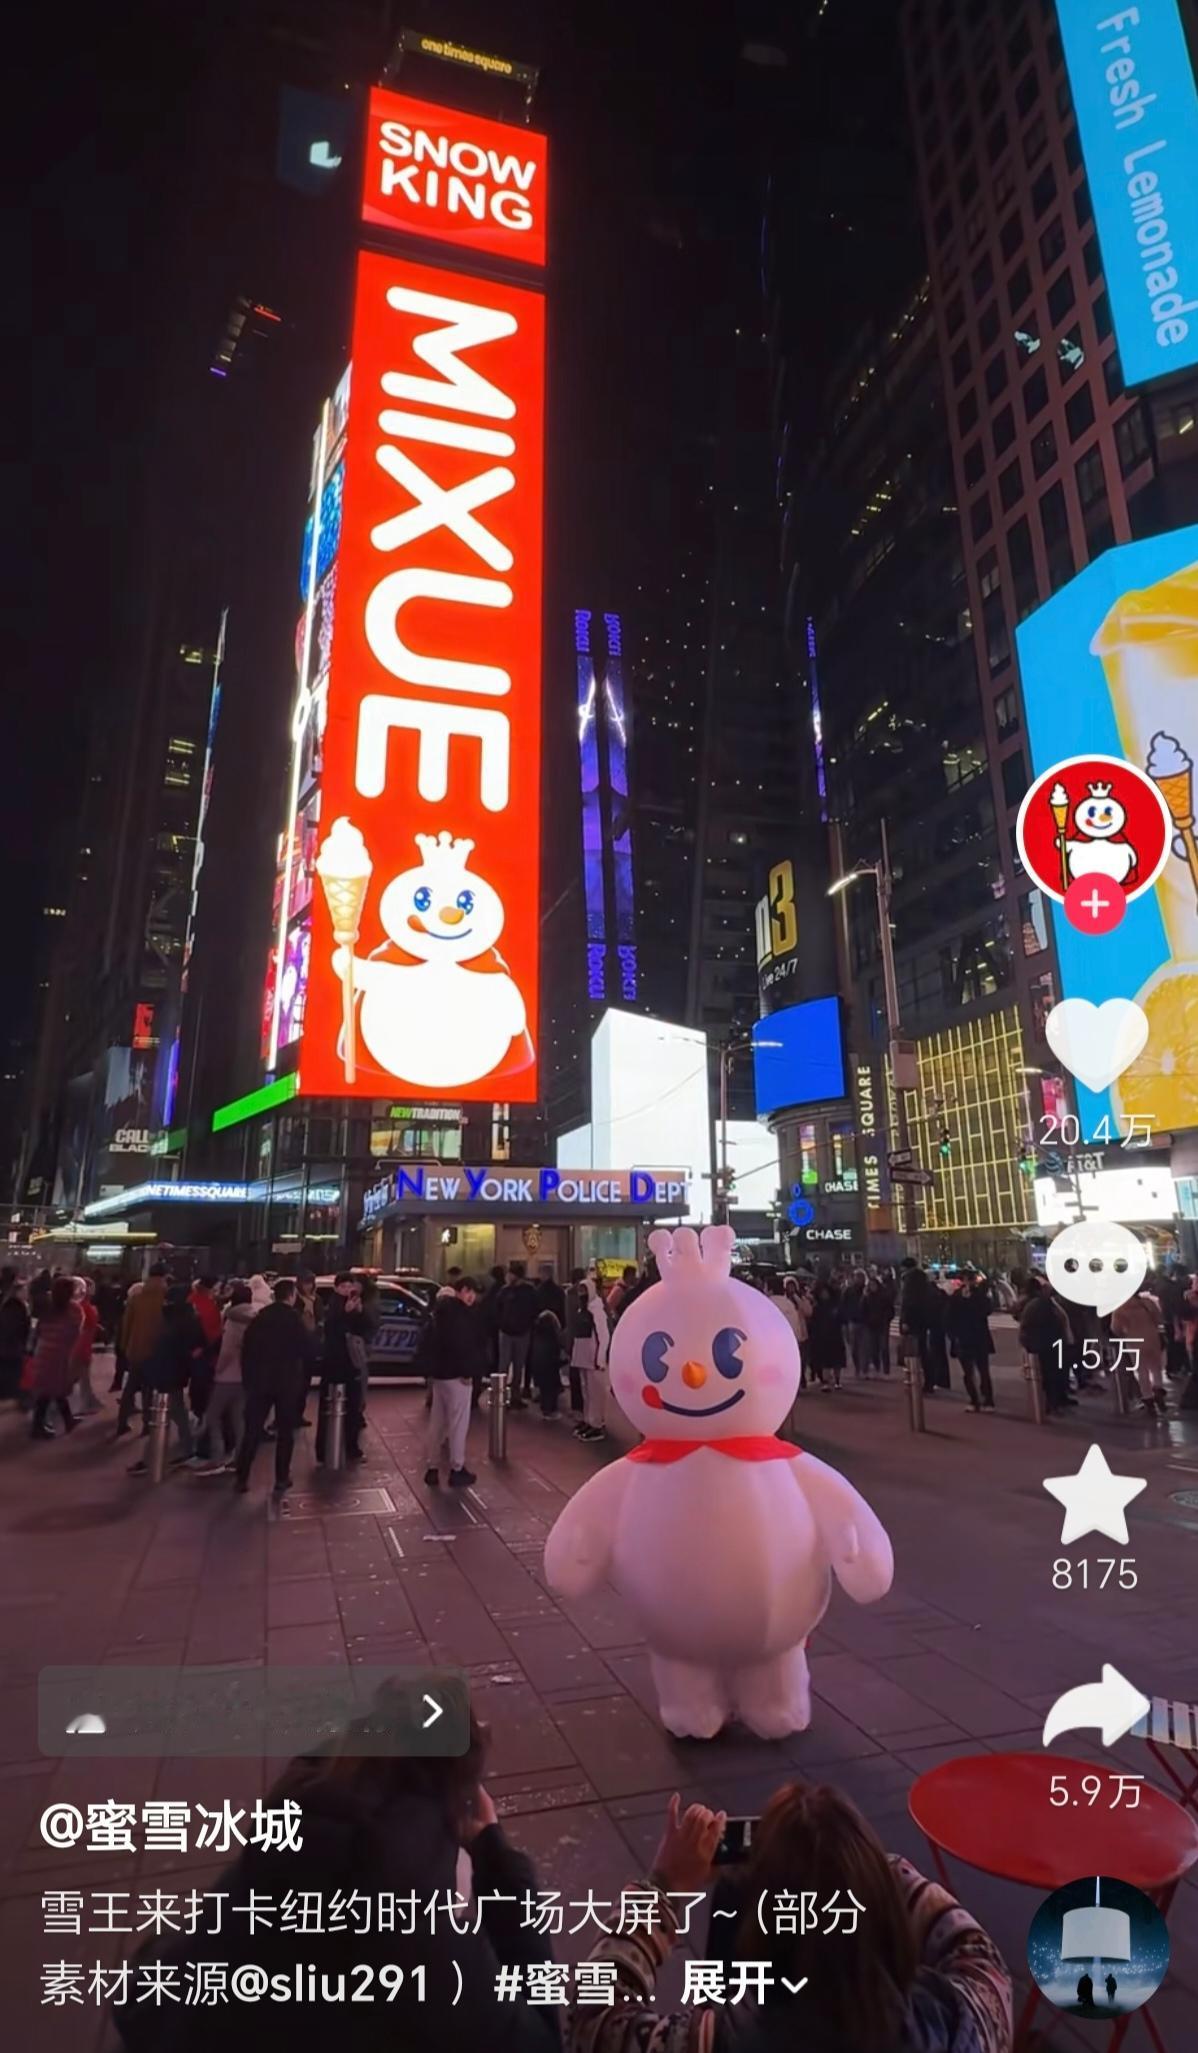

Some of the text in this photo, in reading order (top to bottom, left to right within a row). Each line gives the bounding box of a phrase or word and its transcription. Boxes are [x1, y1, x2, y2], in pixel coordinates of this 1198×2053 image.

[379, 120, 537, 191] SNOW
[1097, 6, 1198, 347] Fresh Lemonade
[381, 157, 533, 231] KING
[355, 286, 519, 812] MIXUE
[395, 1166, 461, 1202] NEW
[463, 1167, 533, 1205] YORK
[539, 1168, 622, 1204] POLICE
[630, 1170, 693, 1204] DEPT
[806, 1229, 852, 1241] CHASE
